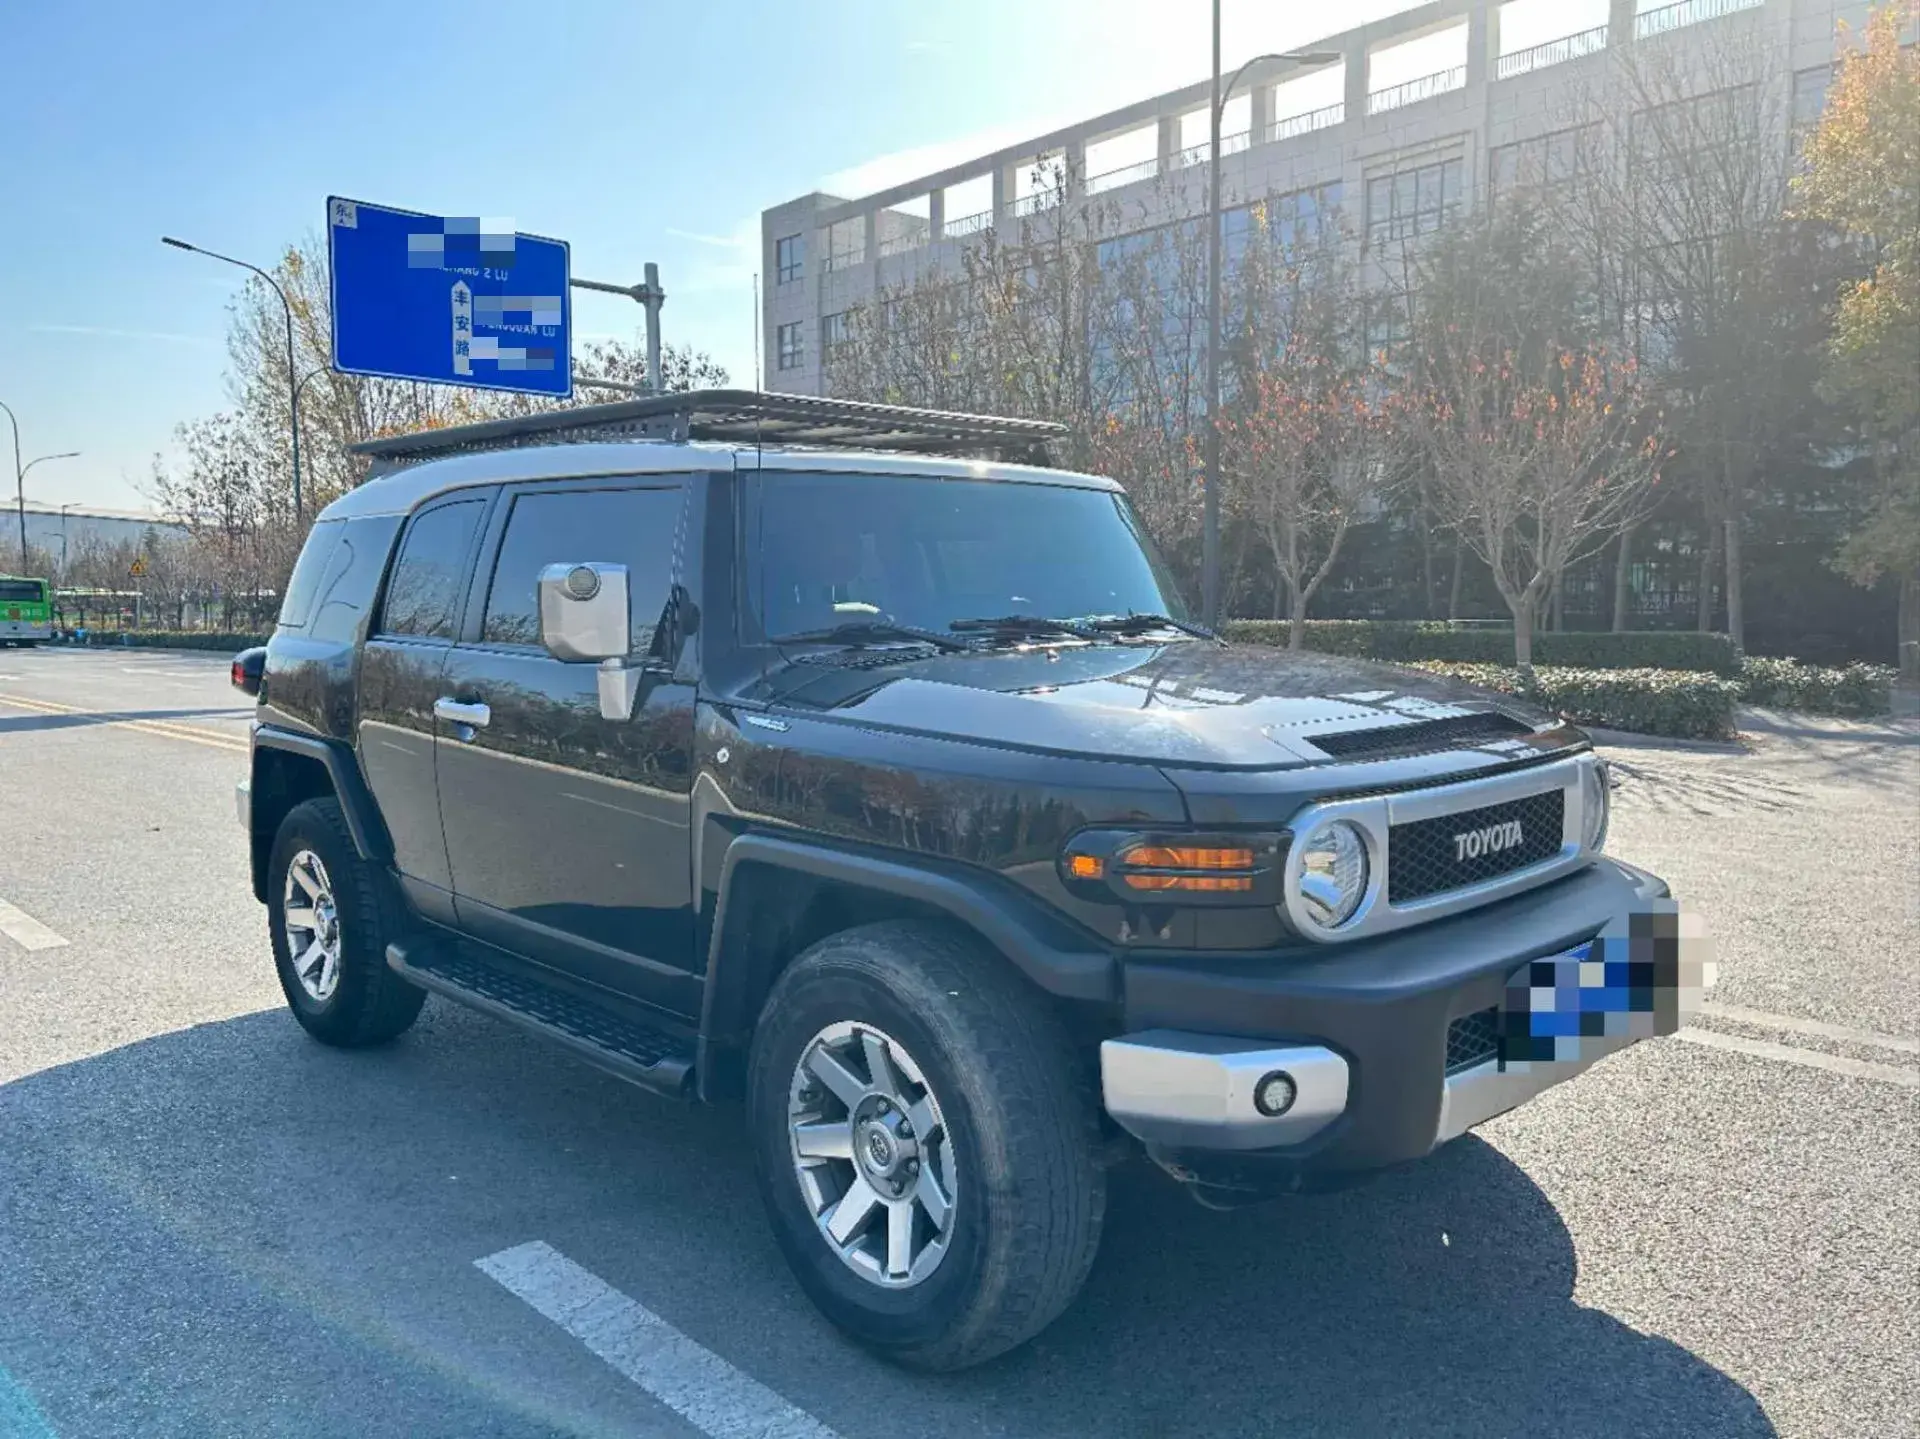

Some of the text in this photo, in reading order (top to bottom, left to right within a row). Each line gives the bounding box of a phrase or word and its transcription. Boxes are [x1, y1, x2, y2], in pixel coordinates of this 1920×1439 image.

[494, 268, 508, 281] LU
[542, 325, 556, 337] LU
[1454, 820, 1523, 862] TOYOTA
